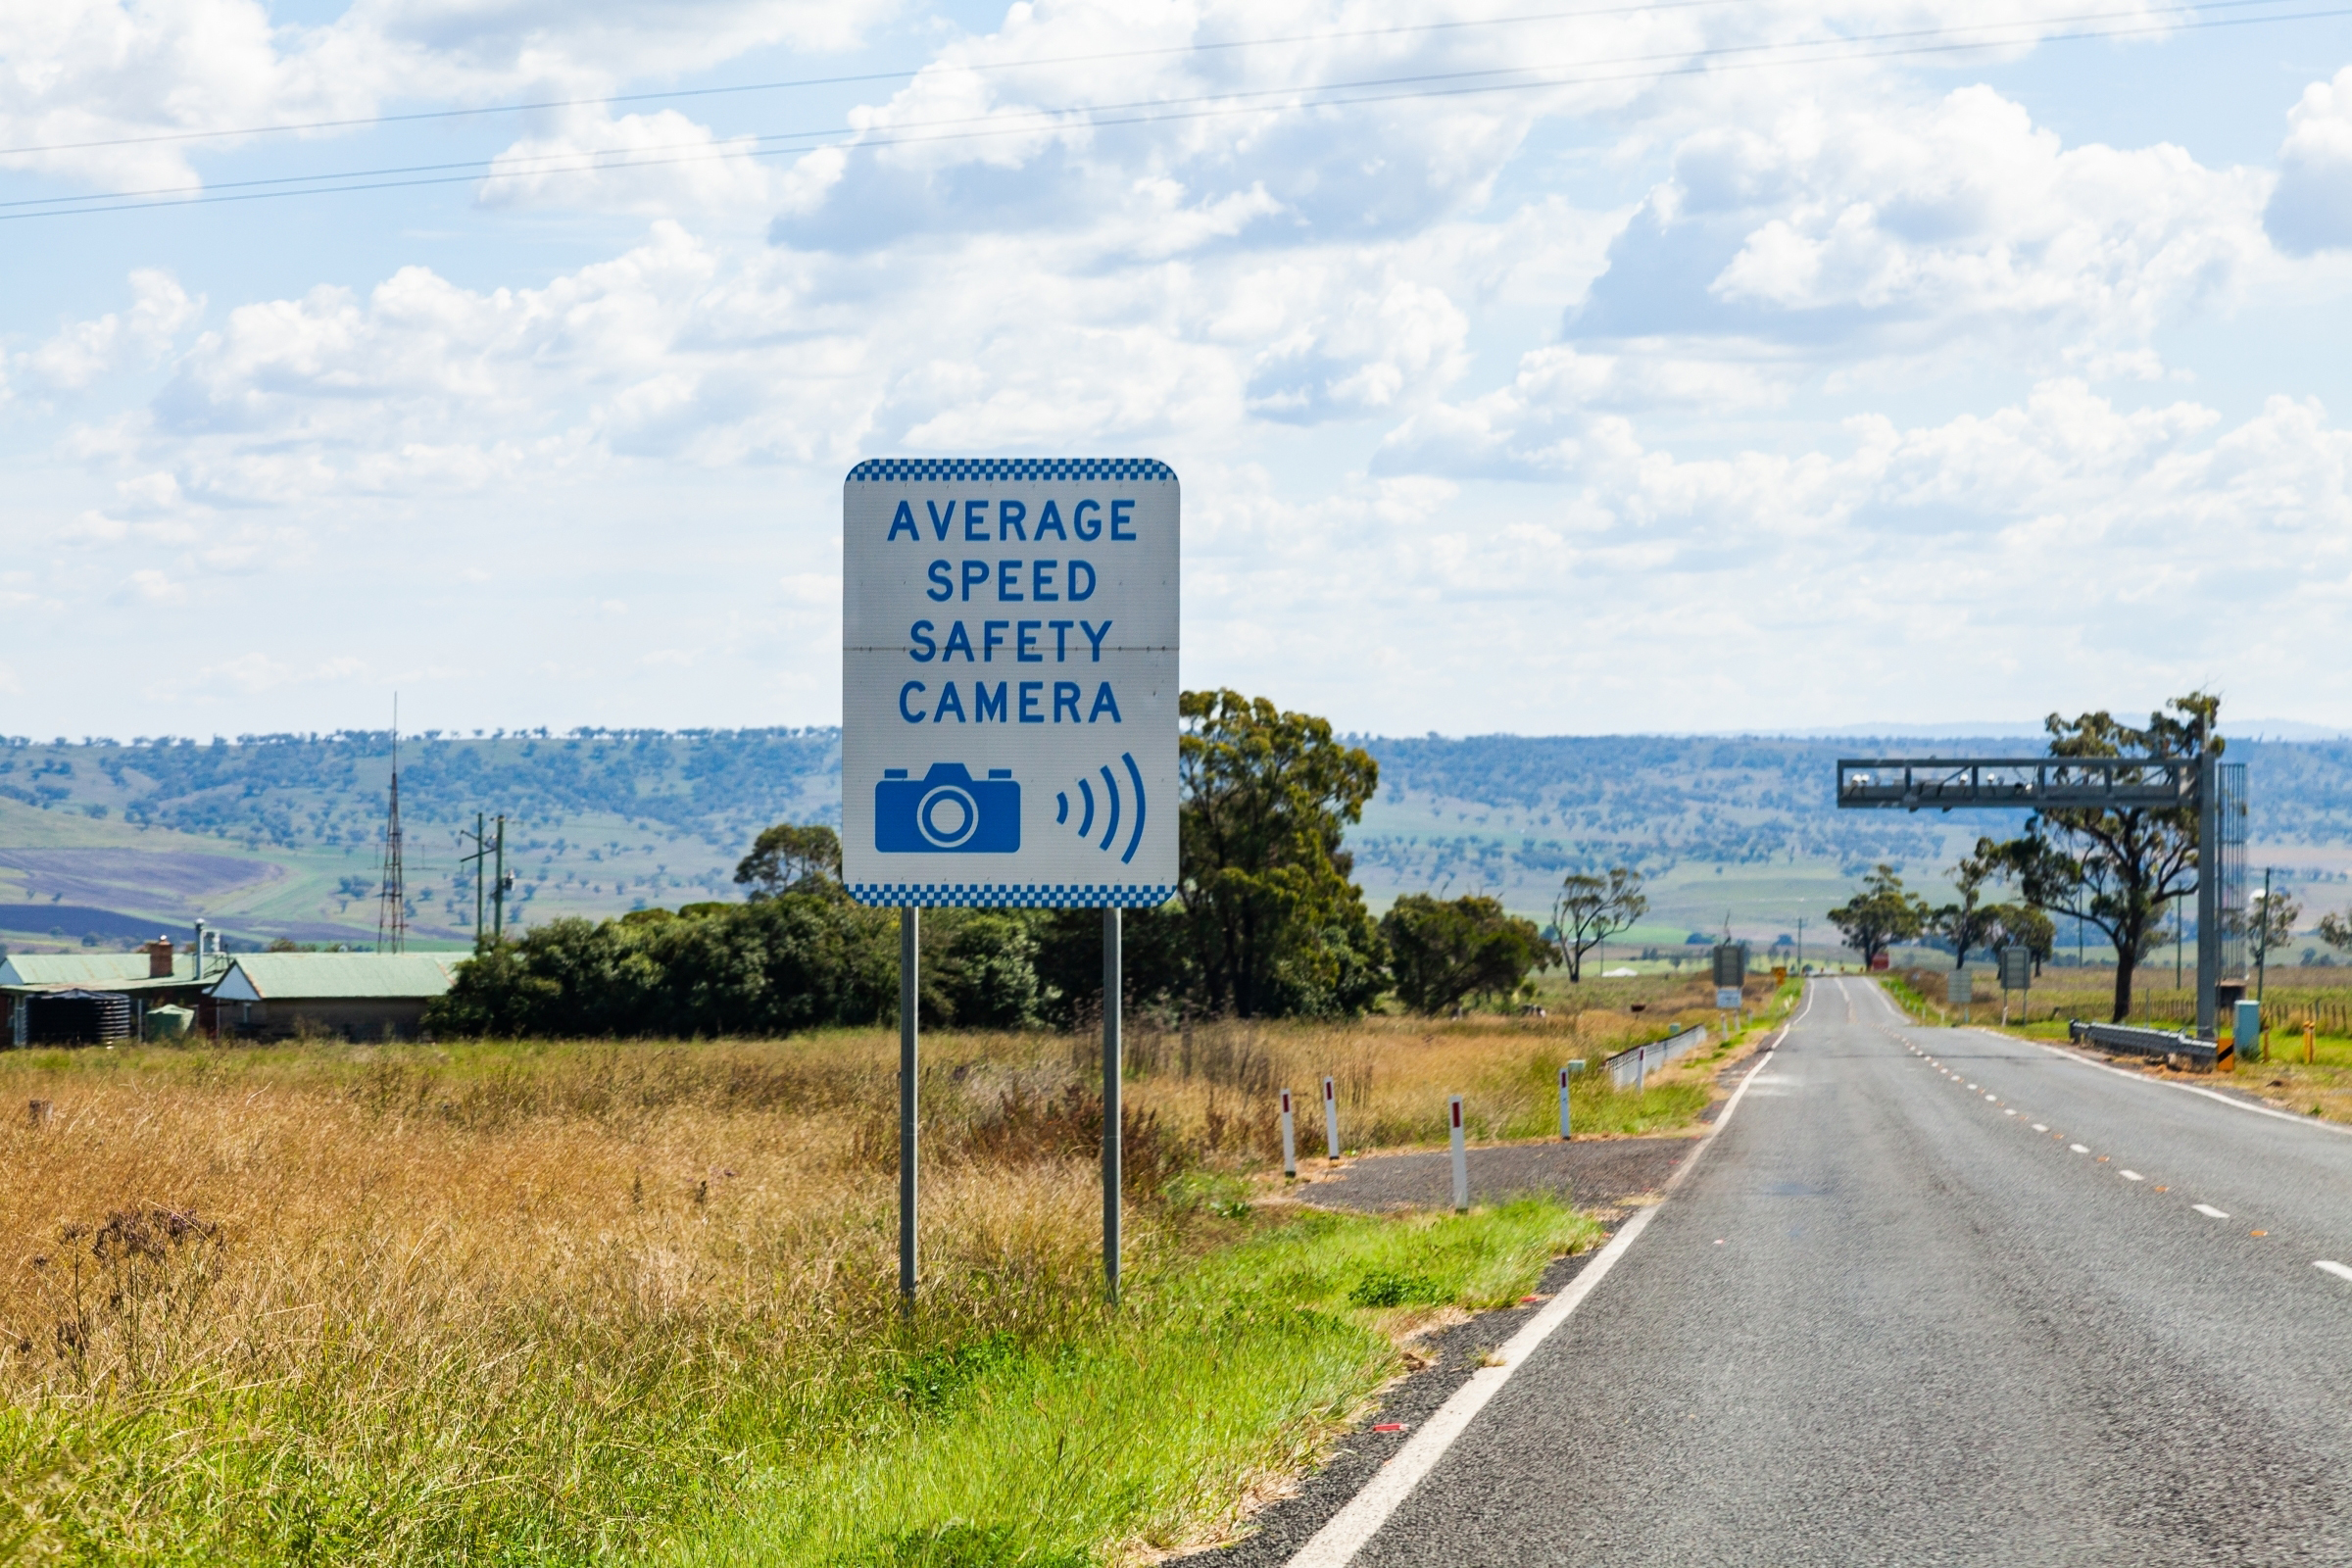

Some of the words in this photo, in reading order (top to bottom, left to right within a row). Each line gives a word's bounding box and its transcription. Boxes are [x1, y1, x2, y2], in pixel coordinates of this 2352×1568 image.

[887, 499, 1137, 541] AVERAGE
[926, 558, 1097, 602] SPEED
[908, 618, 1112, 662] SAFETY
[899, 679, 1121, 723] CAMERA
